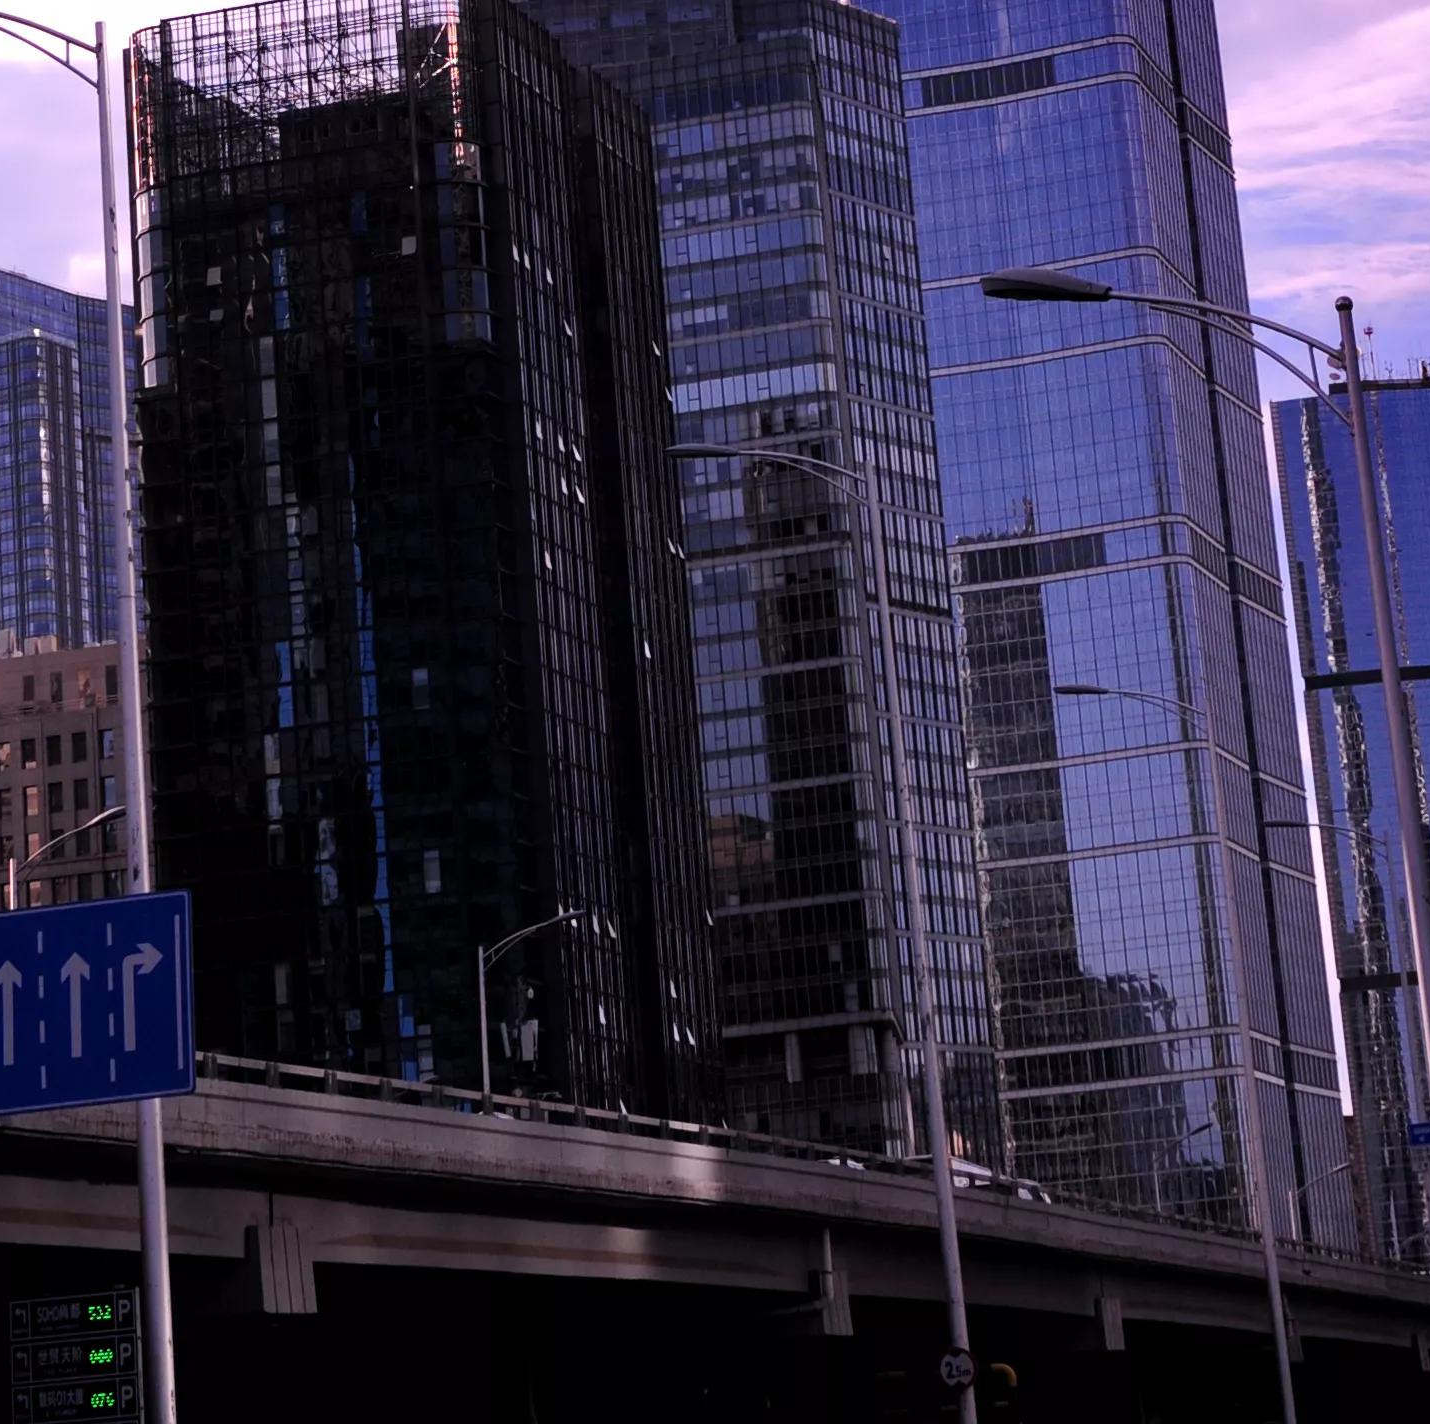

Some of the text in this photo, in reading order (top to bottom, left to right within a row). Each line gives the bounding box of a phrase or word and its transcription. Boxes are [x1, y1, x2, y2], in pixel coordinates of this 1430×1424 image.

[119, 1299, 131, 1323] P
[120, 1343, 132, 1367] P
[121, 1385, 134, 1410] P
